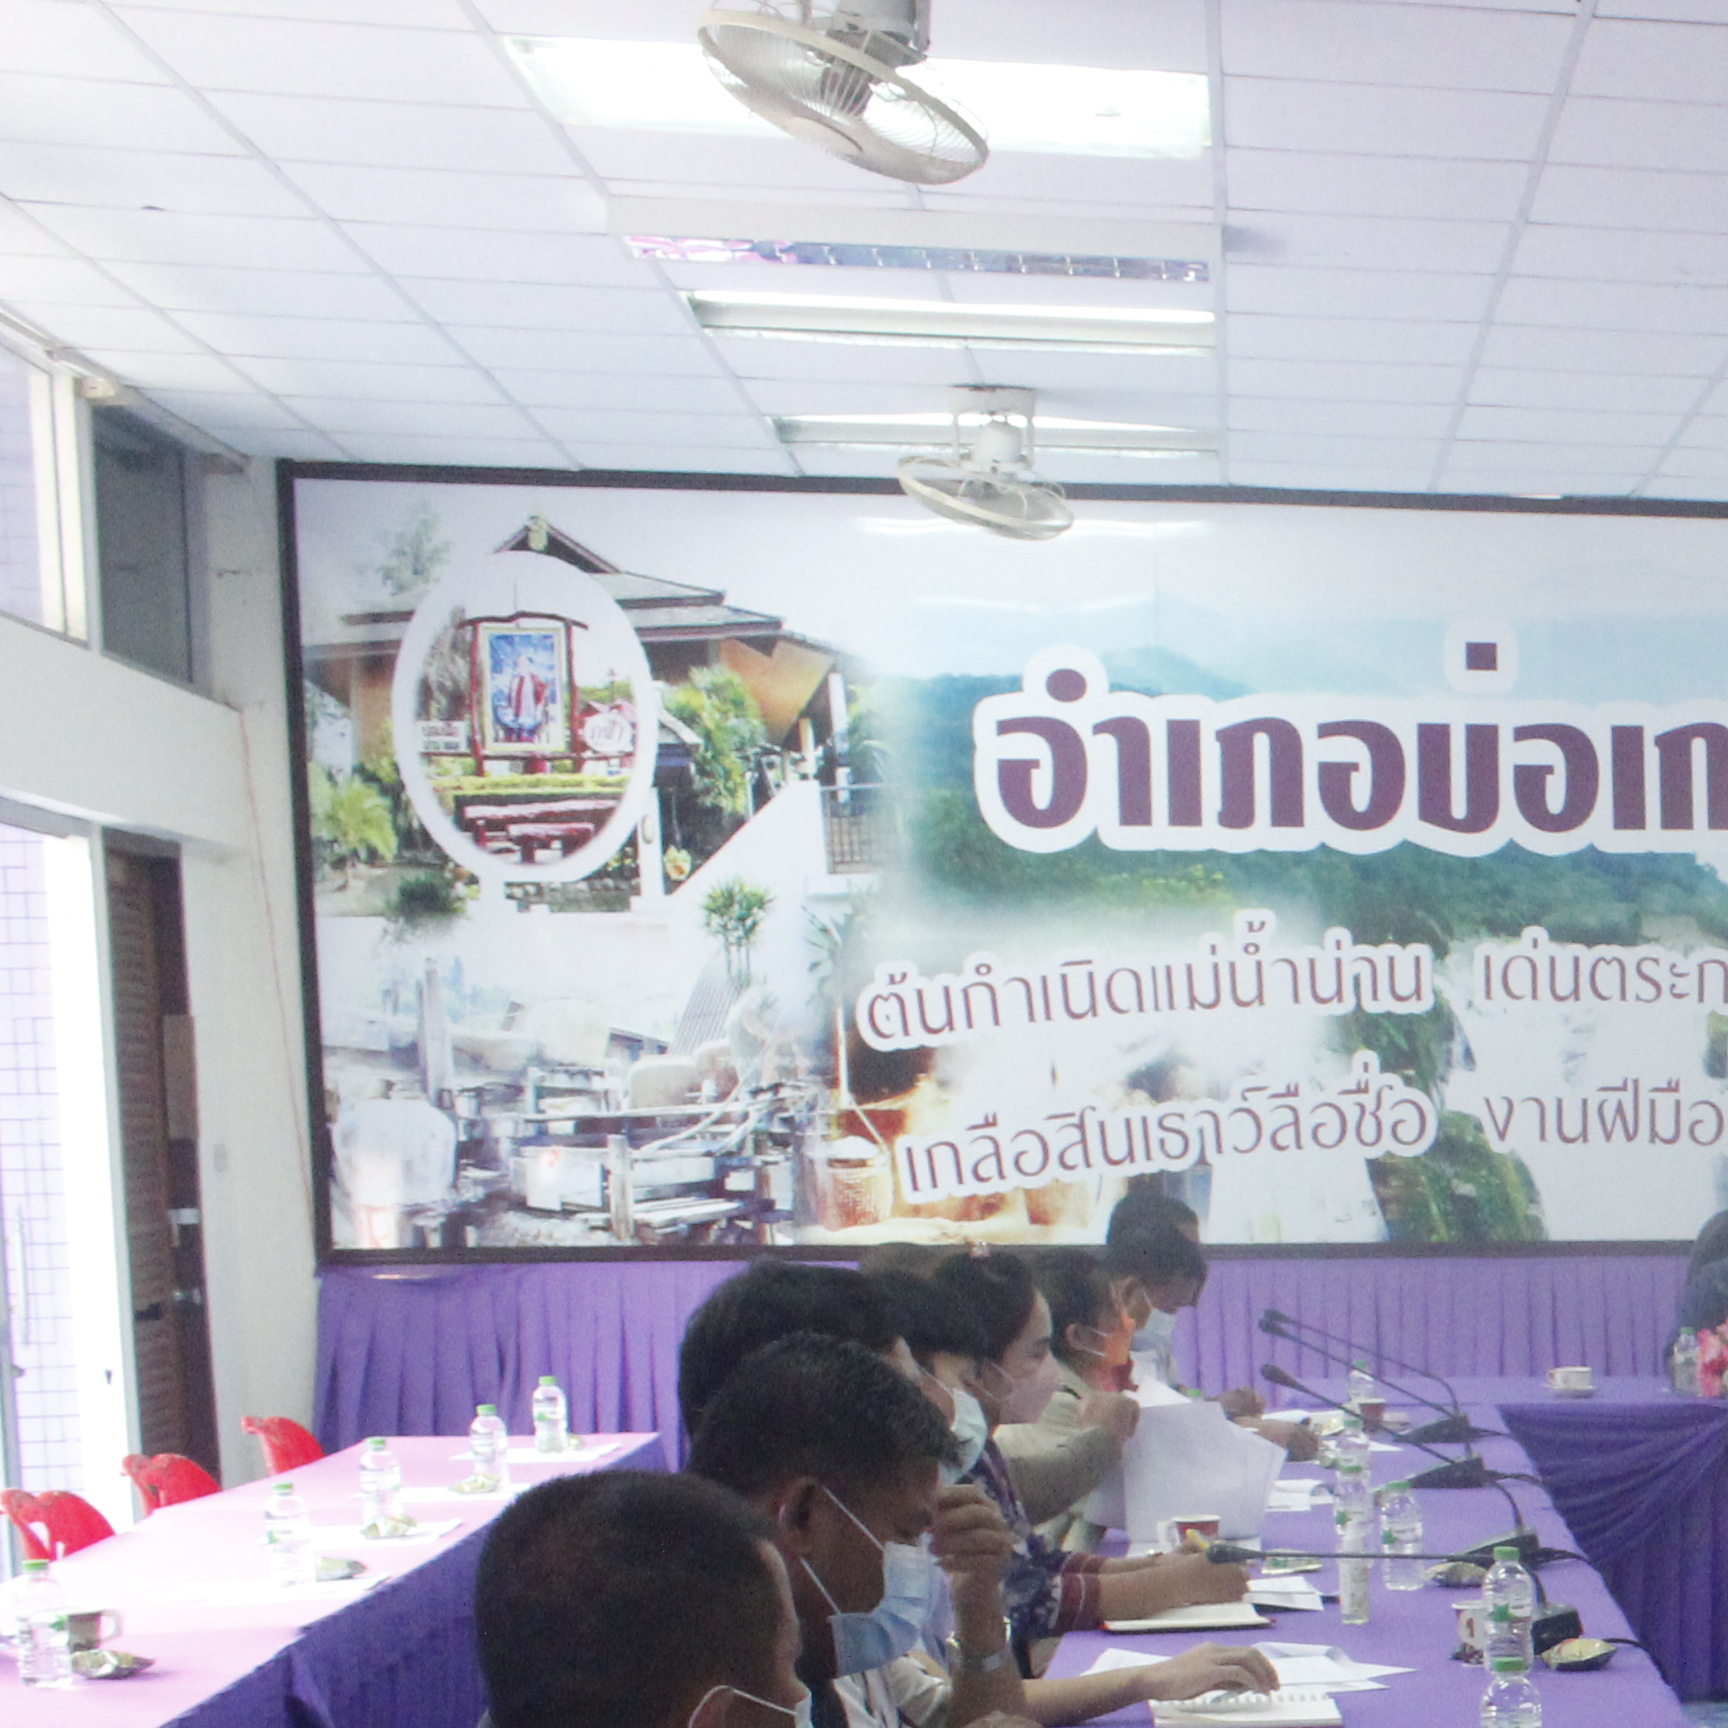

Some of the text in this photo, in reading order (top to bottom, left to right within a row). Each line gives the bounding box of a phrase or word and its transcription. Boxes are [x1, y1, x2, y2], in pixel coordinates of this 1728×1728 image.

[867, 920, 1424, 1039] ต้นกำเนิดแม่น้ำน่าน
[905, 1062, 1427, 1193] เกลือสินเธาว์ลือชื่อ
